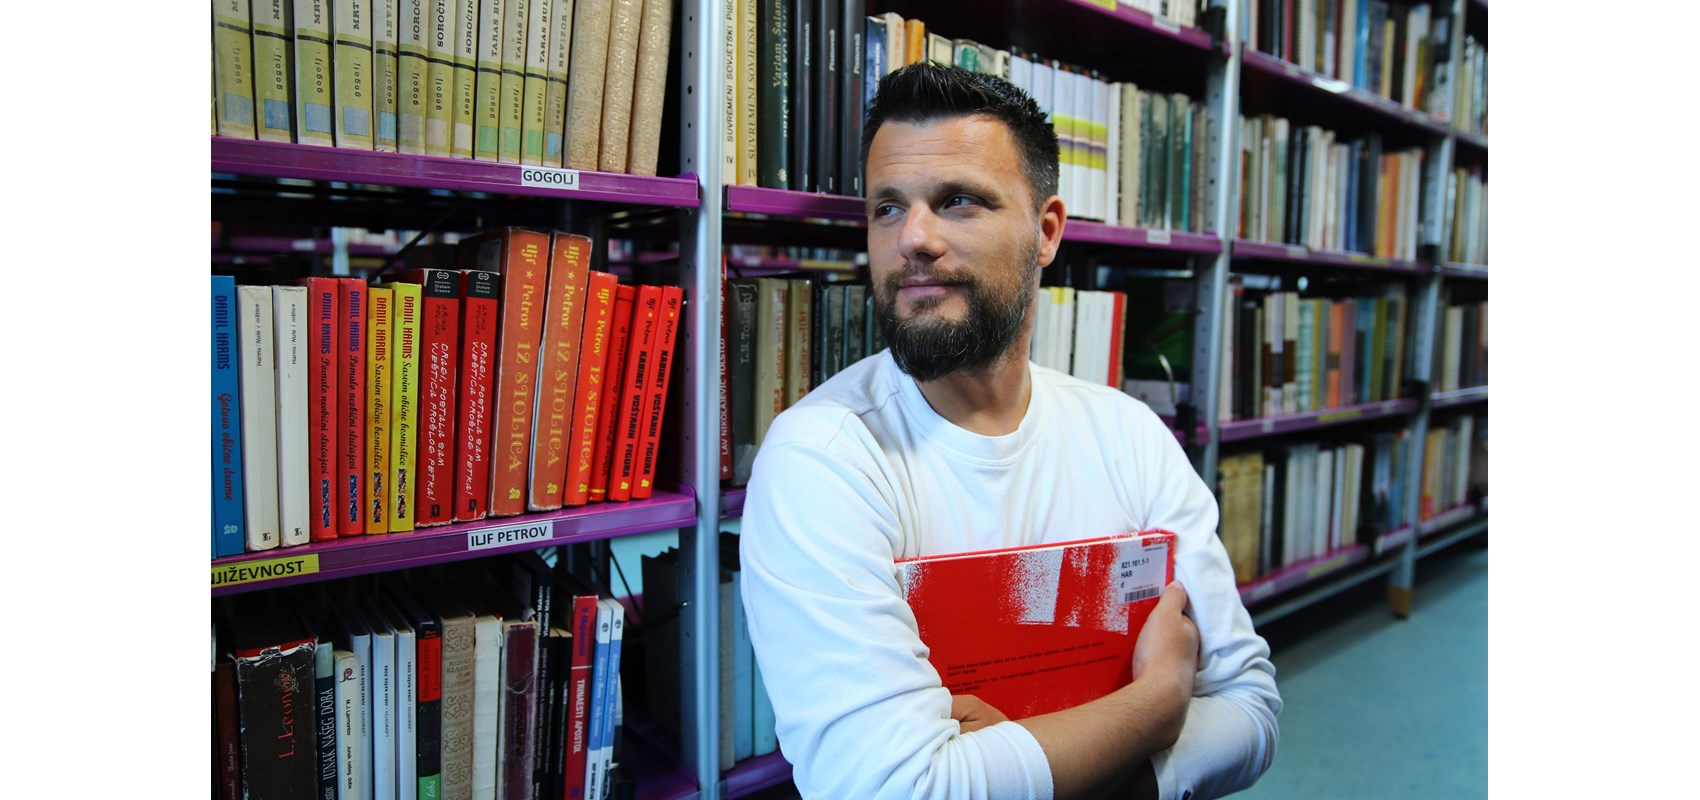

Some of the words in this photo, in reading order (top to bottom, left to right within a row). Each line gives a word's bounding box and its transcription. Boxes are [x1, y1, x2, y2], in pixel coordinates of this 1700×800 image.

[540, 26, 548, 64] TARAS
[726, 25, 734, 80] SOVJETSKI
[748, 19, 756, 82] SOVJETSKI
[828, 28, 836, 71] Pismovnik
[772, 42, 782, 88] Varlam
[726, 84, 734, 142] SUVREMENI
[748, 86, 756, 160] SUVREMENI
[523, 170, 574, 185] GOGOLJ
[214, 295, 228, 330] DANIIL
[322, 292, 332, 320] DANIIL
[350, 291, 361, 319] DANIIL
[376, 297, 388, 326] DANIIL
[404, 296, 414, 325] DANIIL
[520, 284, 534, 330] Petrov
[560, 284, 575, 330] Petrov
[740, 292, 752, 340] Tolstoj
[321, 323, 331, 354] HARMS
[349, 321, 360, 352] HARMS
[375, 329, 387, 362] HARMS
[402, 327, 413, 359] HARMS
[593, 320, 606, 357] Petrov
[642, 320, 652, 346] Petrov
[663, 320, 674, 346] Petrov
[216, 333, 230, 370] HARMS
[516, 341, 531, 364] 12
[556, 340, 571, 362] 12
[612, 340, 626, 394] Generation
[374, 364, 384, 396] Sasvim
[402, 361, 412, 393] Sasvim
[588, 366, 601, 386] 12
[634, 350, 647, 391] KABINET
[656, 350, 669, 389] KABINET
[217, 392, 232, 429] Gotovo
[374, 398, 384, 424] obične
[400, 395, 410, 422] obične
[508, 372, 528, 473] STOLICA
[547, 370, 568, 468] STOLICA
[626, 394, 641, 440] VOŠTANIH
[648, 394, 662, 438] VOŠTANIH
[374, 426, 384, 469] besmislice
[400, 423, 410, 466] besmislice
[579, 390, 598, 472] STOLICA
[465, 454, 474, 496] PETKA!
[622, 444, 634, 478] FIGURA
[642, 442, 655, 476] FIGURA
[426, 458, 436, 500] PETKA!
[470, 532, 494, 547] ILJF
[498, 526, 548, 544] PETROV
[1120, 570, 1133, 578] HAR
[320, 688, 334, 716] DOBA
[575, 679, 586, 718] TRINAESTI
[318, 717, 335, 748] NAŠEG
[573, 720, 582, 754] APOSTOL
[426, 780, 436, 798] doba
